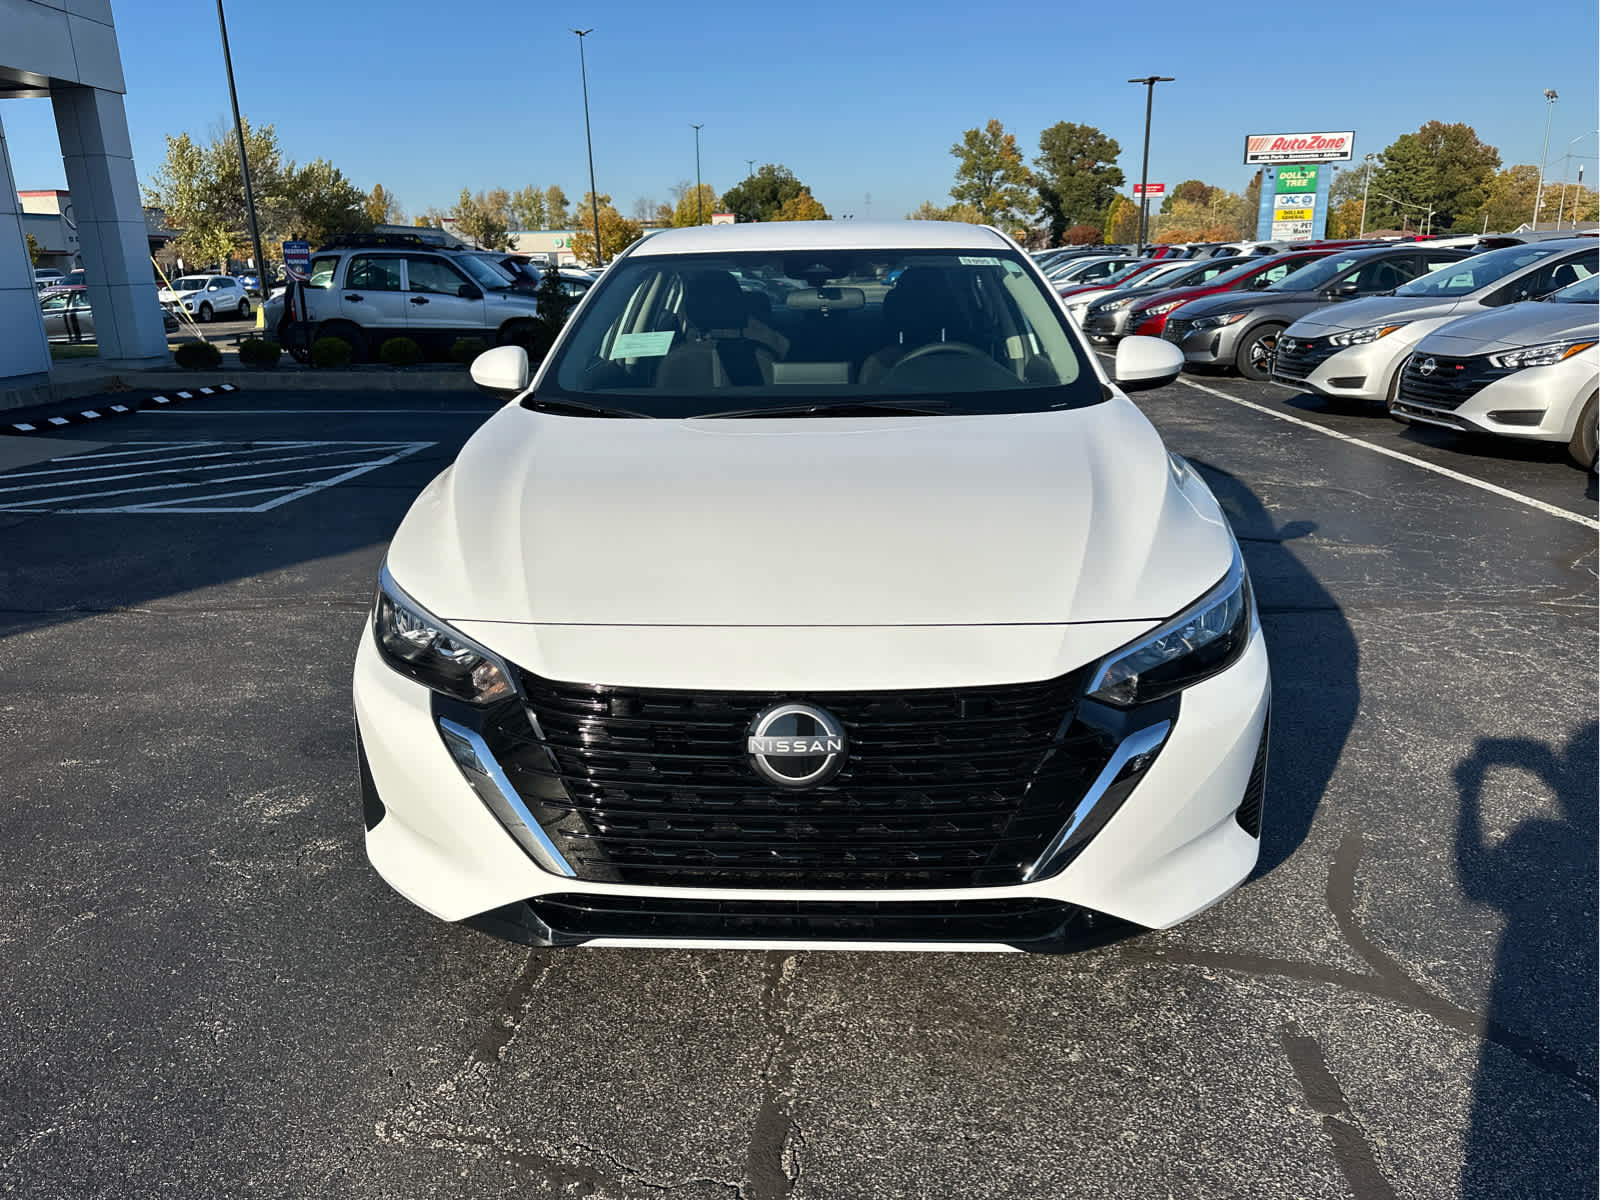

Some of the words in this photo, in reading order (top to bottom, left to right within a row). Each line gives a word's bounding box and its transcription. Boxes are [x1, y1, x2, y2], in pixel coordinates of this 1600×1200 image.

[1270, 135, 1345, 151] AutoZone
[1279, 171, 1316, 179] DOLLAR
[1286, 179, 1309, 187] TREE
[751, 739, 841, 753] NISSAN
